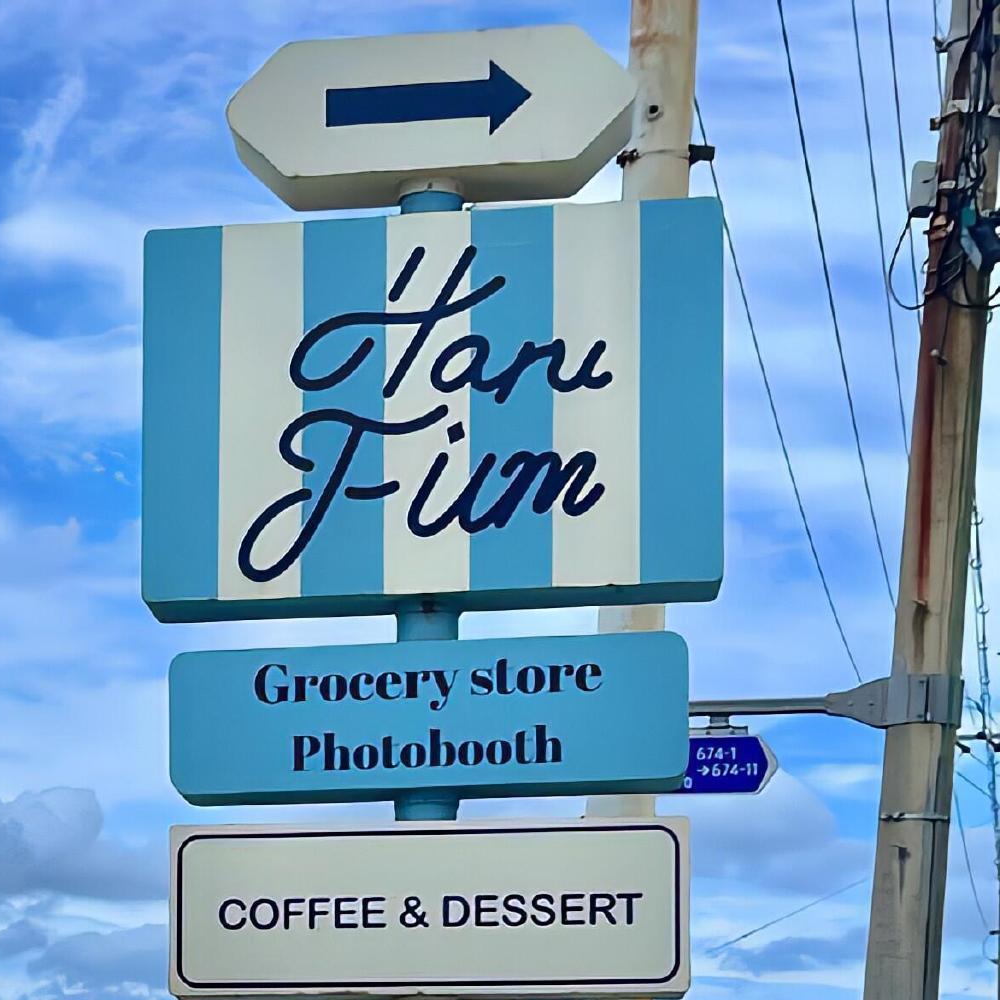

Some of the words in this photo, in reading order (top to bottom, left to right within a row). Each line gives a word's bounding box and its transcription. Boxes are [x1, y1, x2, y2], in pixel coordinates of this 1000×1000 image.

[290, 245, 612, 404] Haru
[255, 664, 458, 710] Grocery
[471, 659, 602, 695] store
[294, 725, 562, 771] Photobooth
[696, 747, 736, 760] 674-1
[219, 897, 386, 930] COFFEE
[400, 897, 429, 927] &
[443, 893, 642, 927] DESSERT
